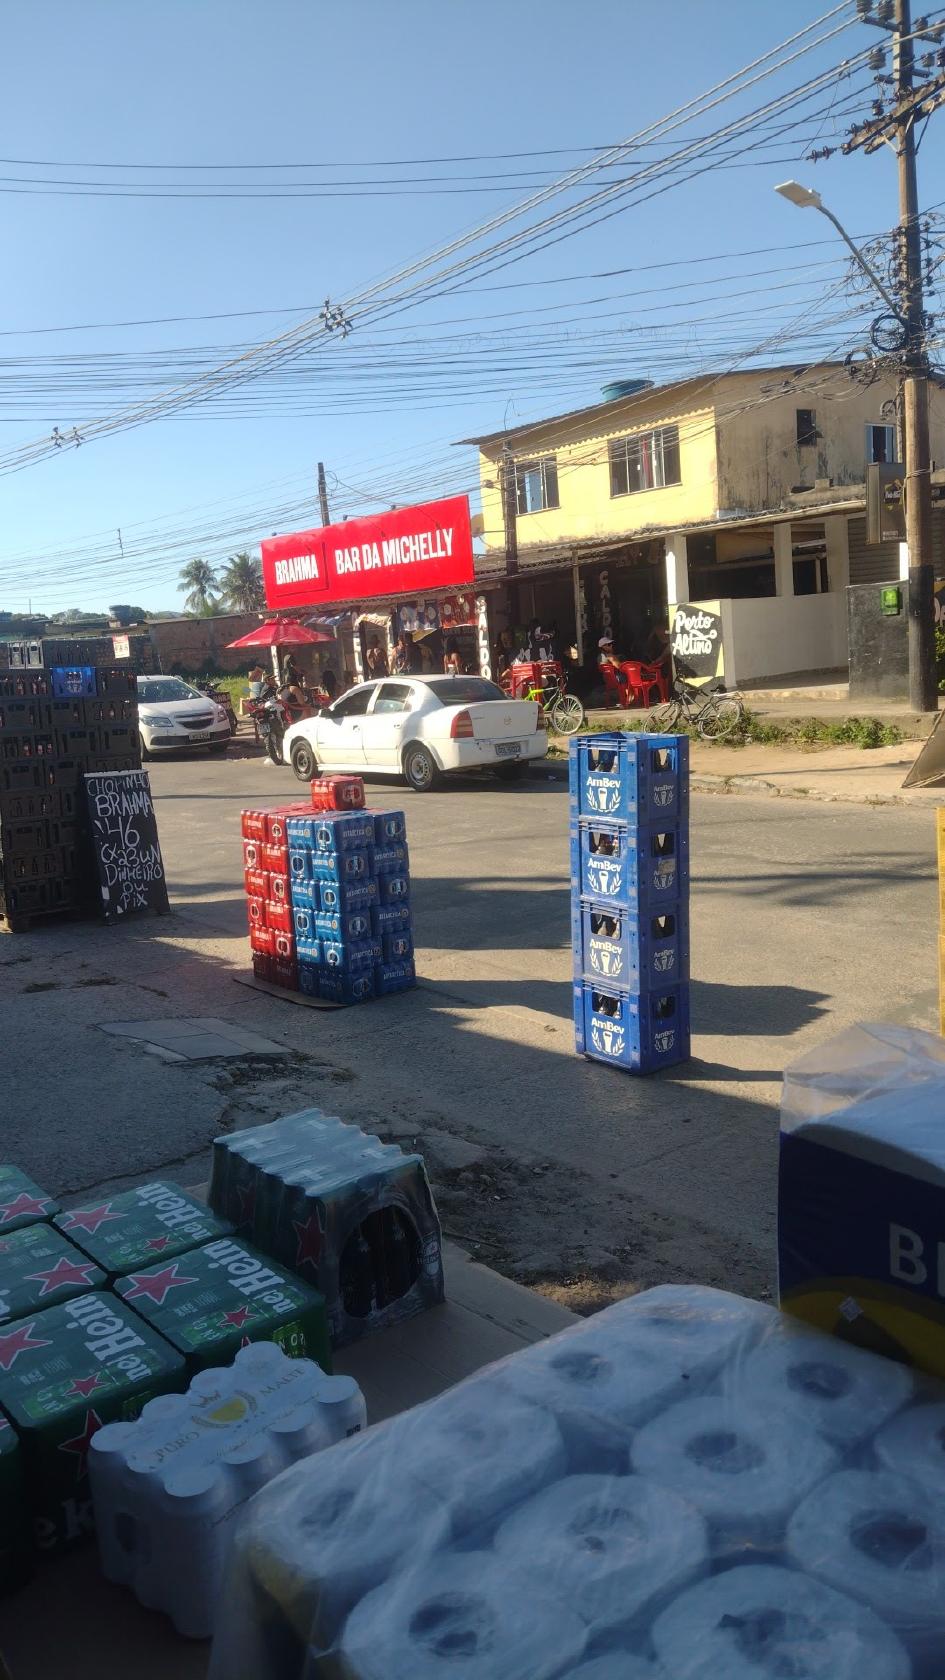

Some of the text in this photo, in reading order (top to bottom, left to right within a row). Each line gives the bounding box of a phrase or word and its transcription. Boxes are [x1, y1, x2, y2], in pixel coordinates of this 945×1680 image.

[334, 527, 454, 575] BAR DA MICHELLY
[274, 554, 319, 585] BRAHMA
[586, 776, 621, 788] AmBev
[95, 791, 154, 817] BRAHMA
[587, 858, 622, 872] AmBev
[590, 938, 623, 955] AmBev
[591, 1017, 625, 1035] AmBev
